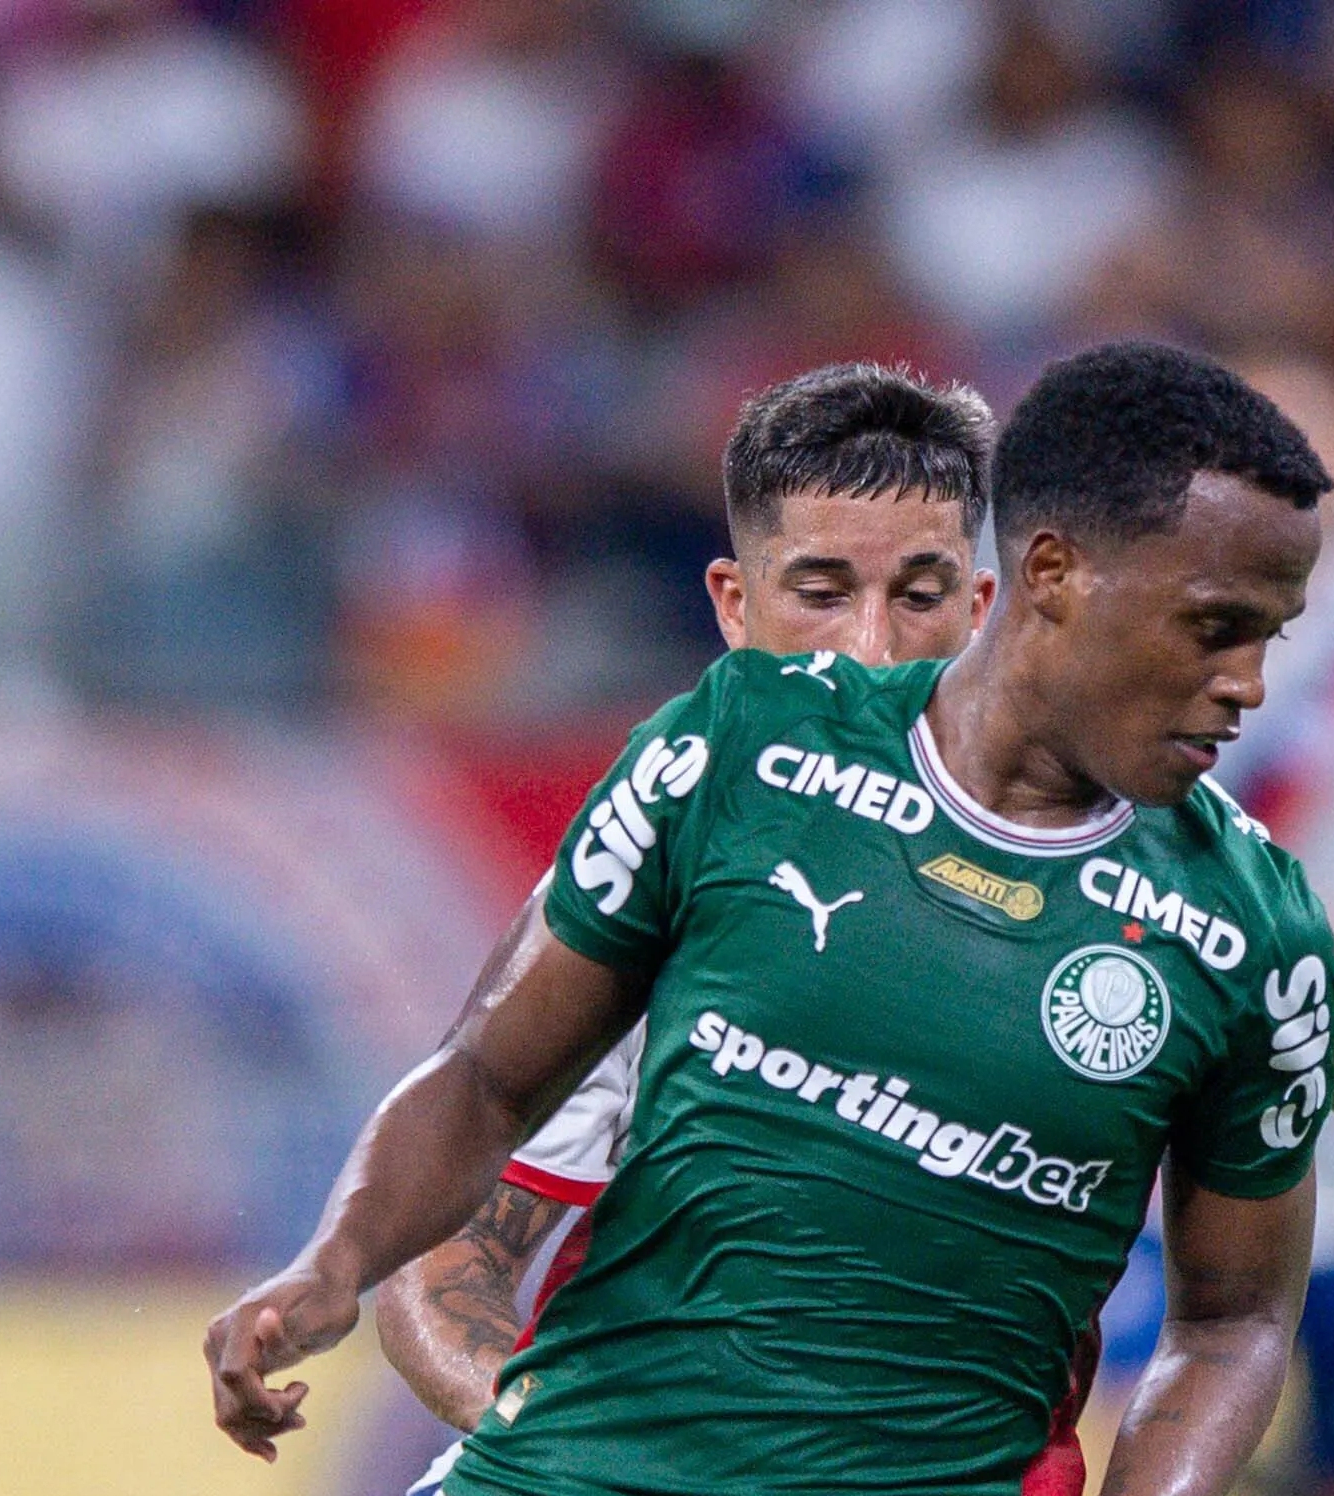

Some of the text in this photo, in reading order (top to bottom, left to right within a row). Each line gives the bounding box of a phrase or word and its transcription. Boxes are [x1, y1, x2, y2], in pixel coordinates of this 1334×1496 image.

[756, 743, 935, 835] CIMED
[931, 860, 1007, 904] AVANTI
[1079, 857, 1246, 971] CIMED
[1050, 987, 1160, 1073] PALMEIRAS
[689, 1011, 1113, 1213] sportingbet
